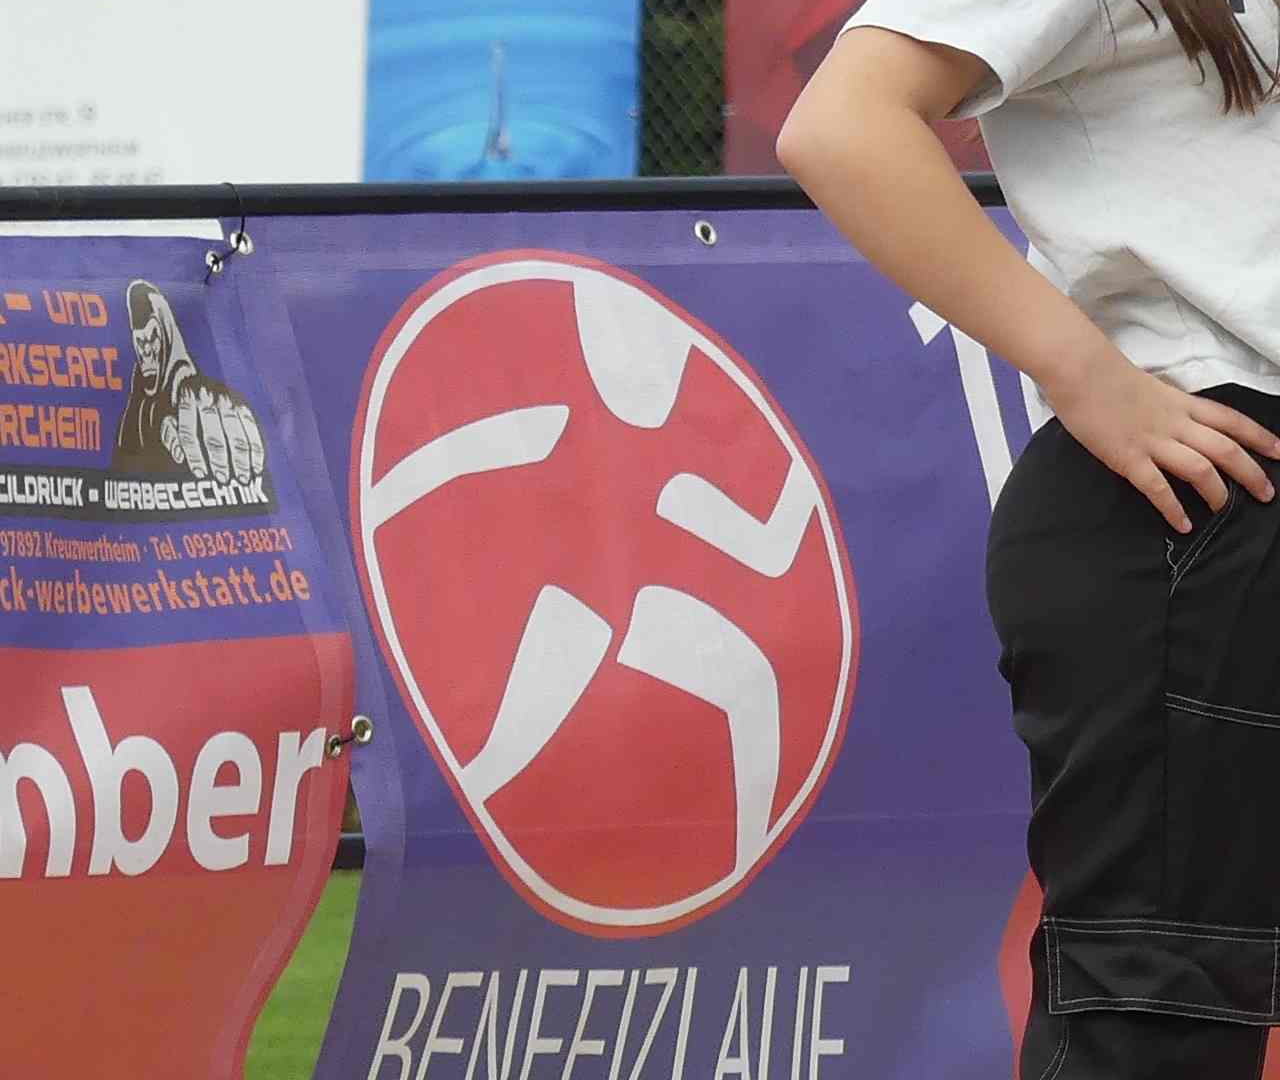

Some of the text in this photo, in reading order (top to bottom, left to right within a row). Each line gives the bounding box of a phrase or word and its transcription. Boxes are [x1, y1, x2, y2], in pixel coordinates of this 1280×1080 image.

[104, 476, 269, 510] WERBETECHNIK
[0, 529, 41, 557] 97892
[44, 532, 140, 563] Kreuzwertheim
[149, 534, 182, 561] Tel.
[184, 527, 295, 559] 09342-38821
